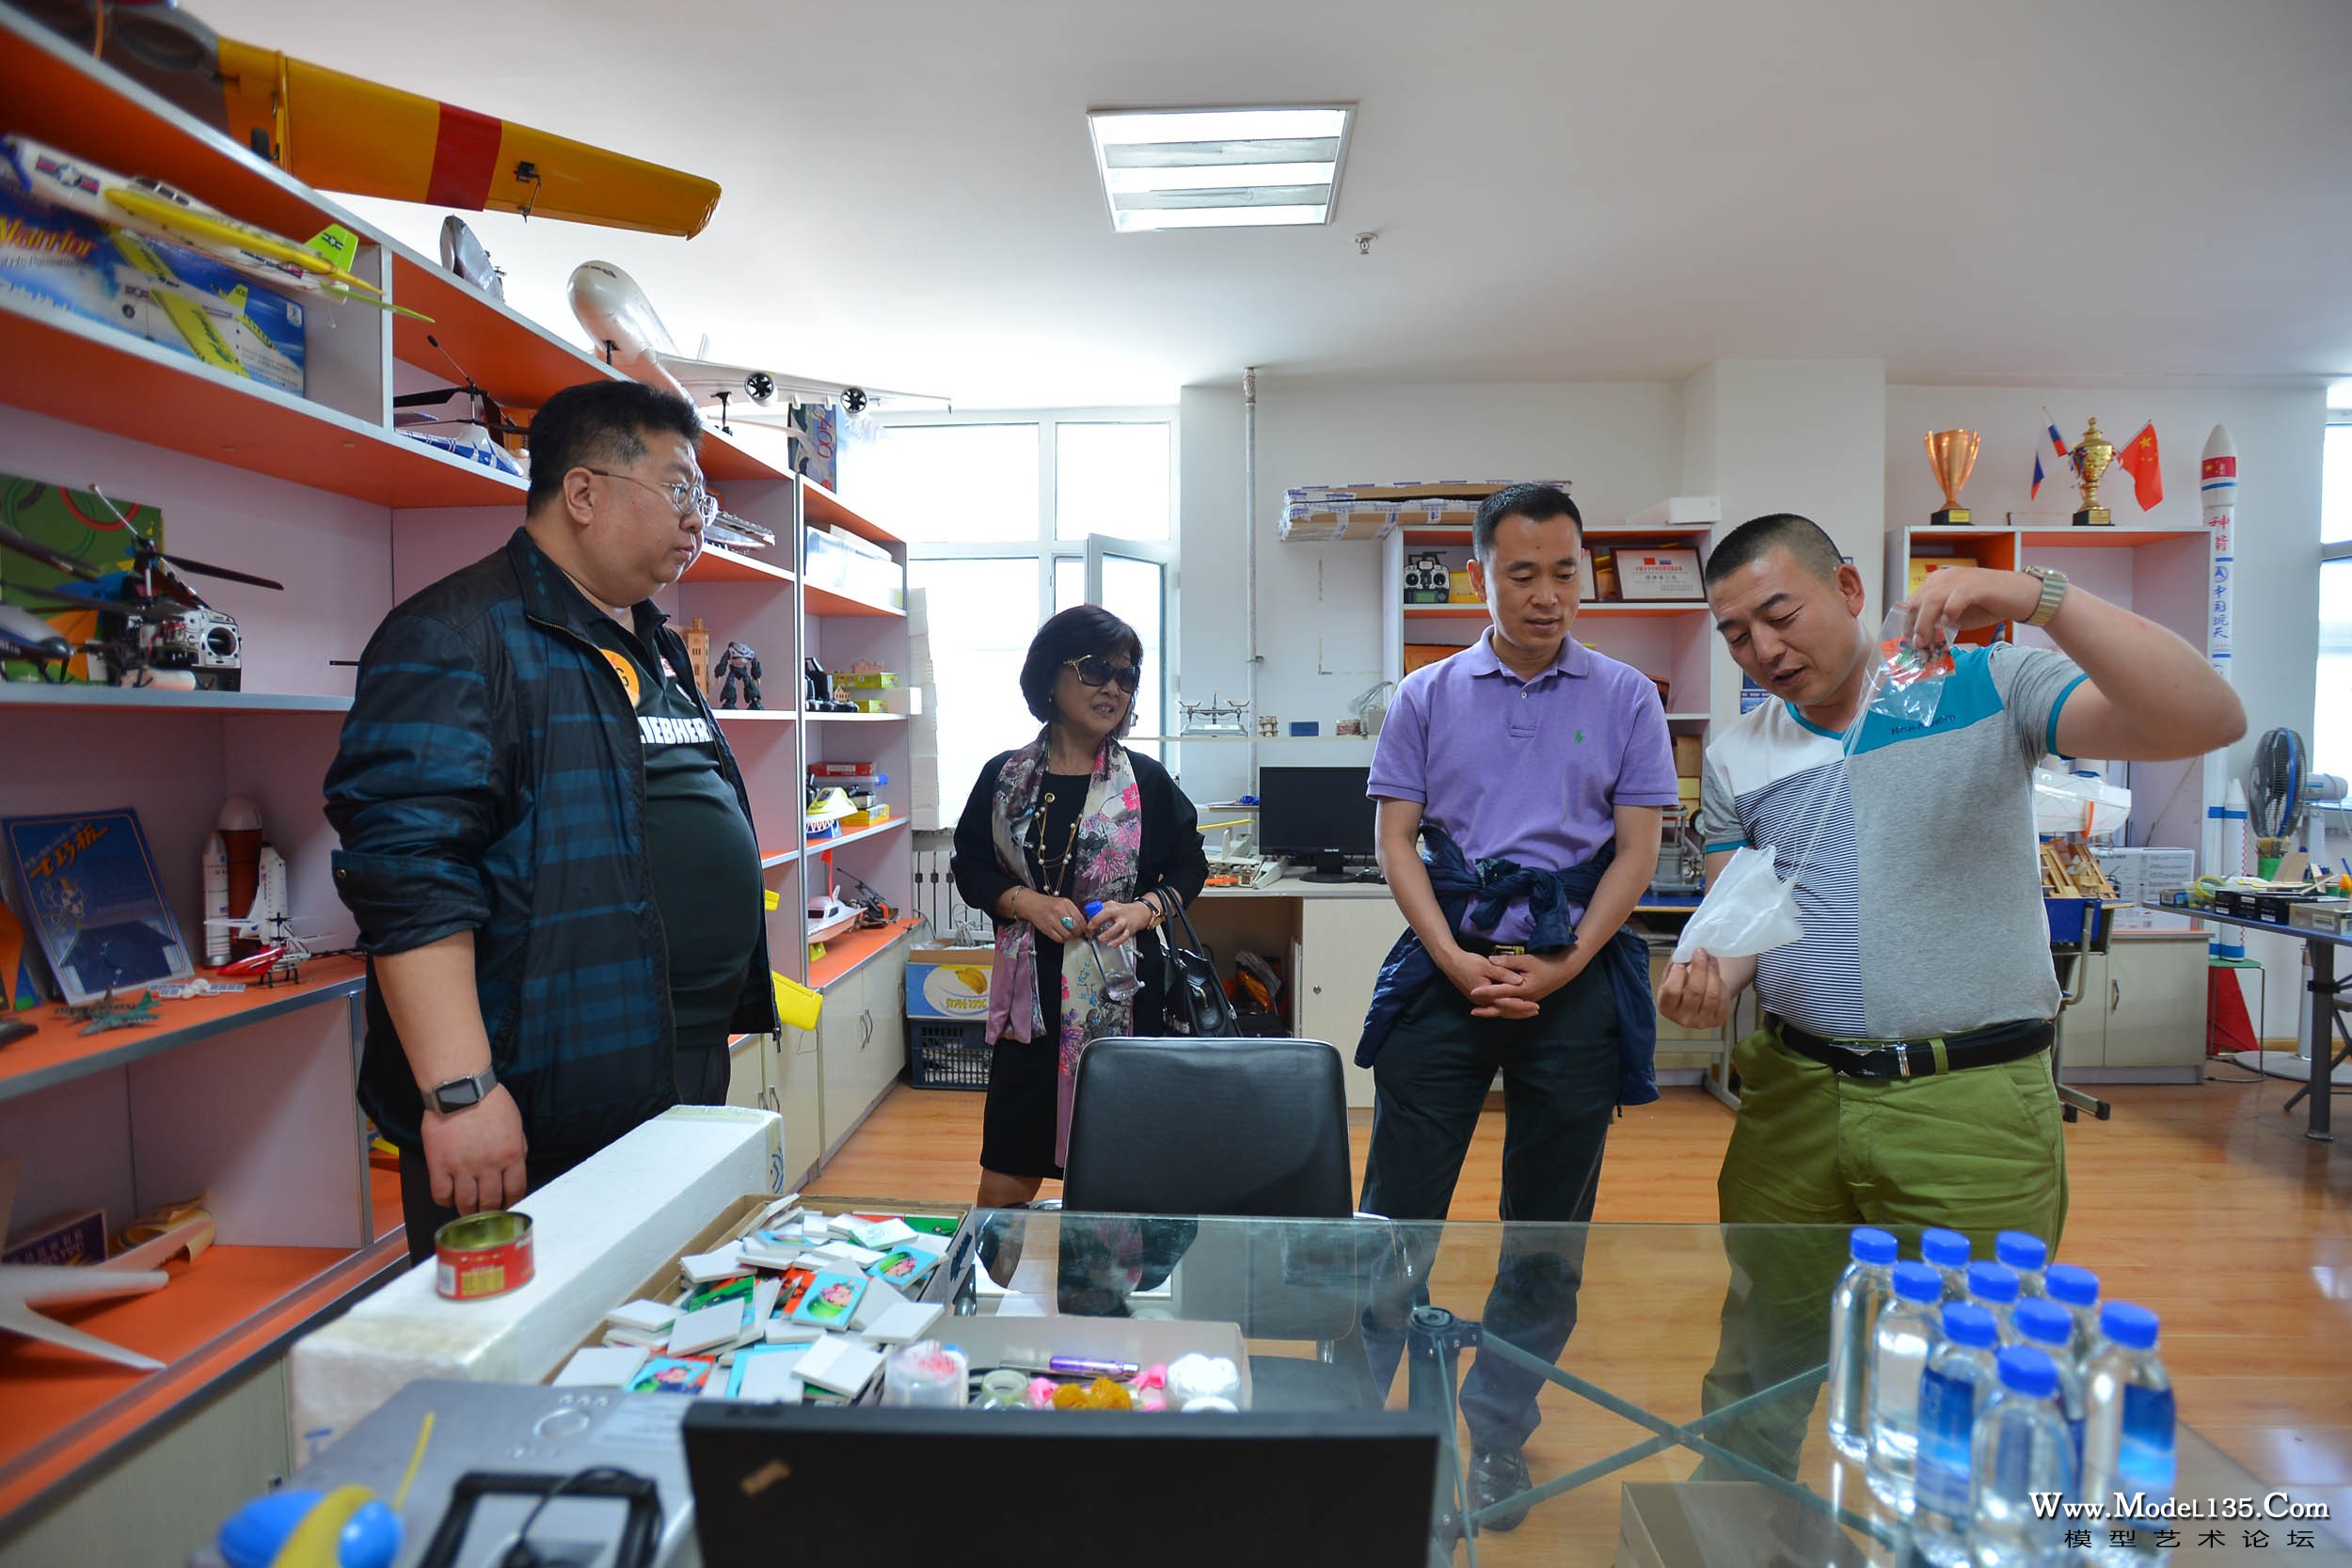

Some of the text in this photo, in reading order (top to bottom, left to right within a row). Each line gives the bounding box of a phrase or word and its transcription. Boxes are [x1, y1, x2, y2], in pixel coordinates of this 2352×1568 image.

[638, 716, 713, 744] IEBHER
[30, 822, 109, 879] 七巧板
